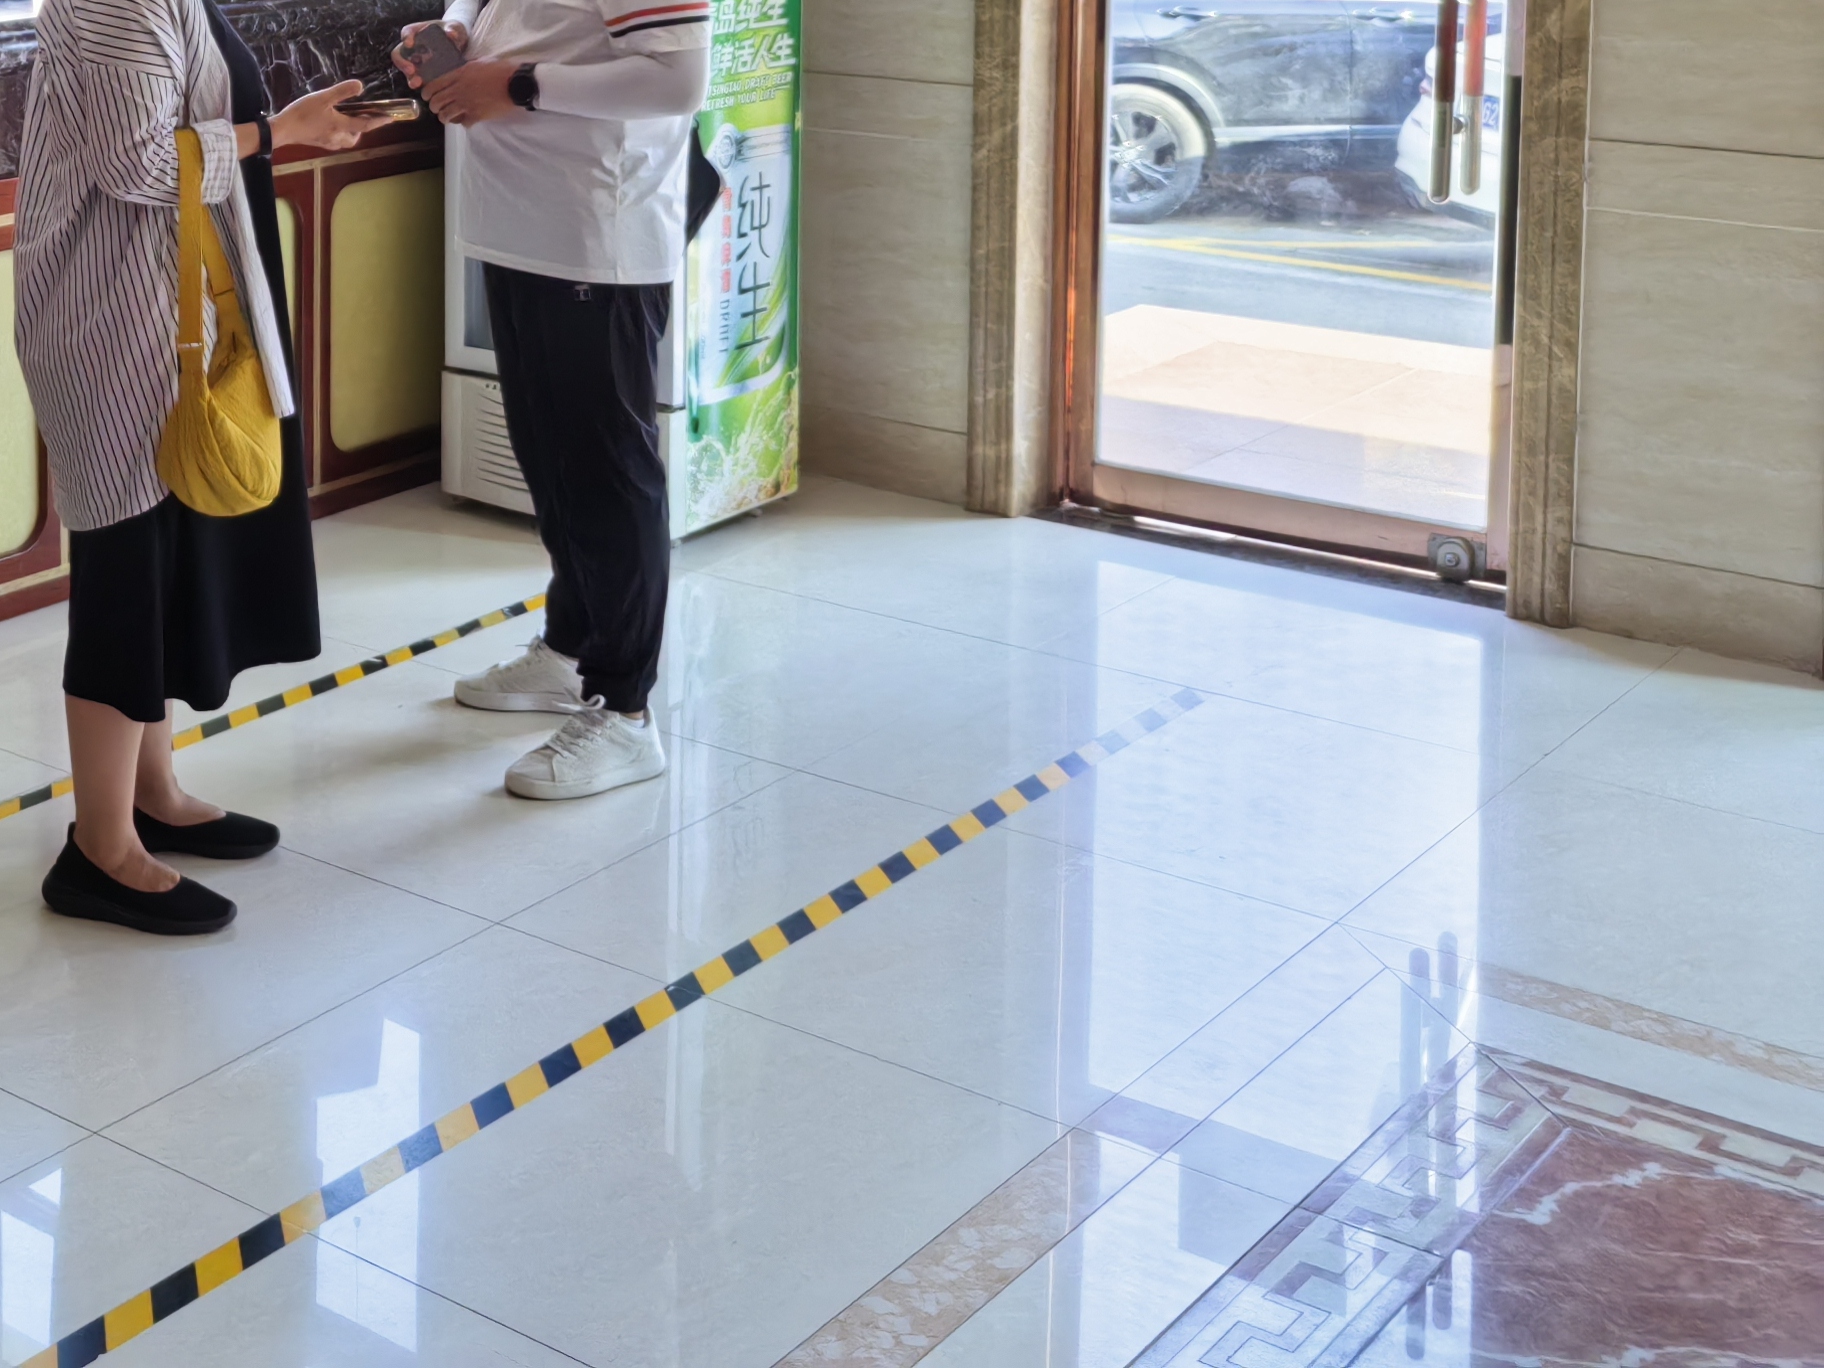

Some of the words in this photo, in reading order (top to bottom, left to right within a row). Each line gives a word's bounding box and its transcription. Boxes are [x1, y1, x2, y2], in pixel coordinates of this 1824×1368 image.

[709, 33, 797, 76] 鲜活人生
[734, 171, 771, 351] 纯生
